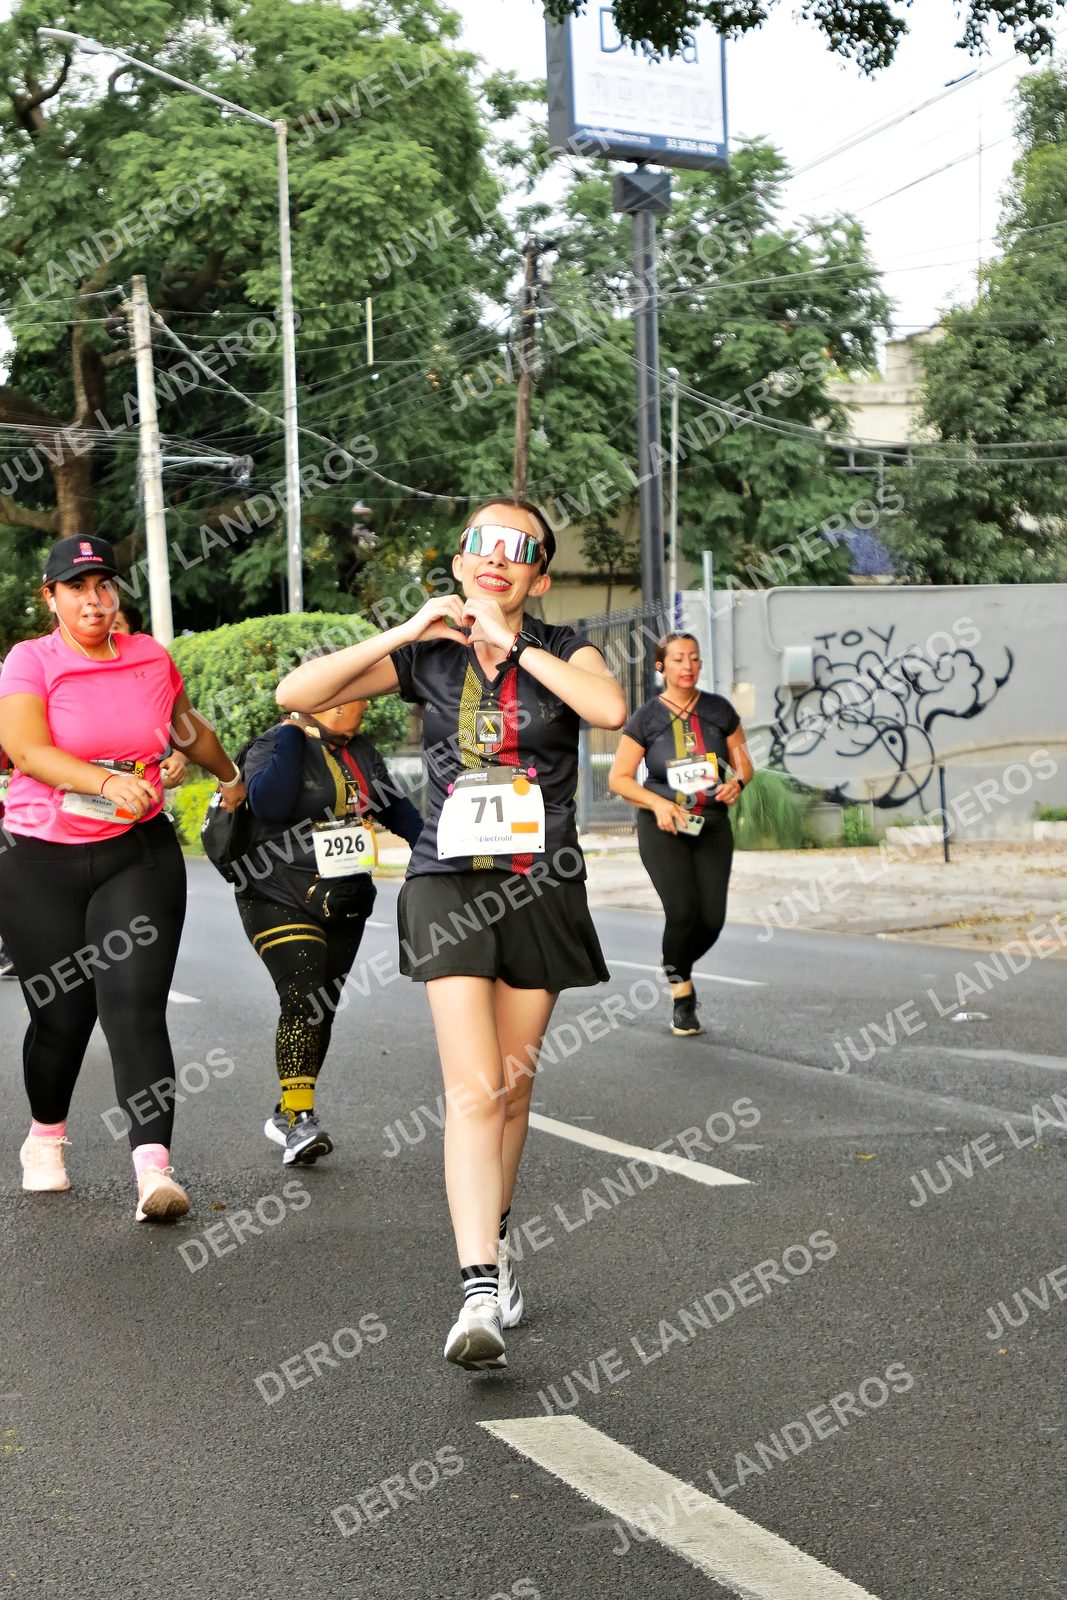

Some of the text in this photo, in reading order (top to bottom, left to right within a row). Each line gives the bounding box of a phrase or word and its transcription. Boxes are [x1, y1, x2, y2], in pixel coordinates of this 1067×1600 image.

[814, 624, 895, 657] TOY
[471, 796, 504, 823] 71
[323, 833, 365, 857] 2926
